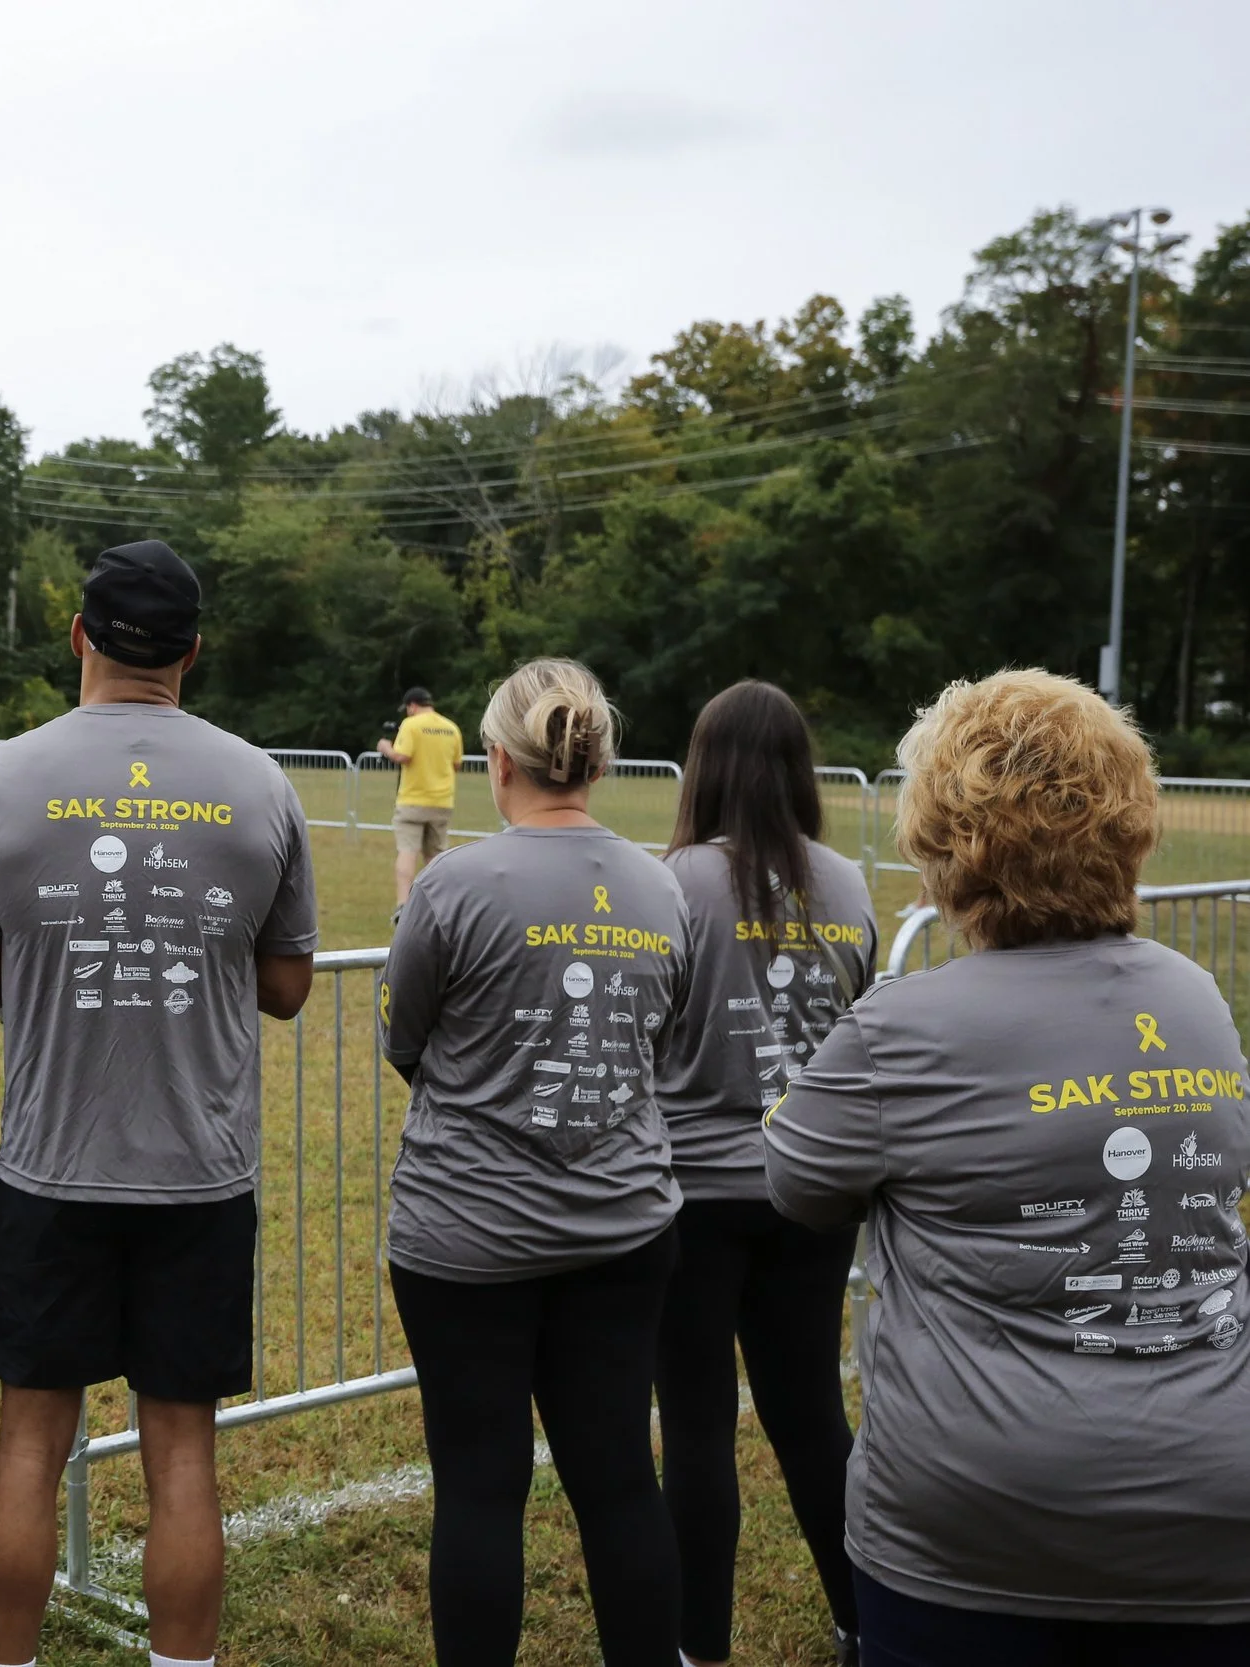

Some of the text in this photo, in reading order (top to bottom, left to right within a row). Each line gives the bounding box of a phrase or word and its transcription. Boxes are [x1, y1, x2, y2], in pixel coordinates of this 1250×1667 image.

[111, 620, 134, 632] COSTA
[46, 798, 232, 825] SAK STRONG
[100, 821, 179, 831] September 20, 2026
[143, 857, 188, 870] High5EM
[47, 883, 79, 892] DUFFY
[145, 914, 185, 926] BoSoma
[526, 924, 671, 956] SAK STRONG
[117, 942, 140, 951] Rotary
[187, 946, 204, 956] City
[572, 948, 608, 957] September
[1029, 1074, 1119, 1113] SAK
[1114, 1102, 1212, 1117] September 20, 2026
[1108, 1148, 1147, 1158] Hanover
[1173, 1153, 1222, 1170] High5EM
[1034, 1198, 1085, 1212] DUFFY
[1189, 1198, 1217, 1209] Spruce
[1116, 1208, 1150, 1218] THRIVE
[1046, 1246, 1062, 1254] Lahey
[1133, 1275, 1162, 1286] Rotary
[1191, 1269, 1218, 1282] Witch
